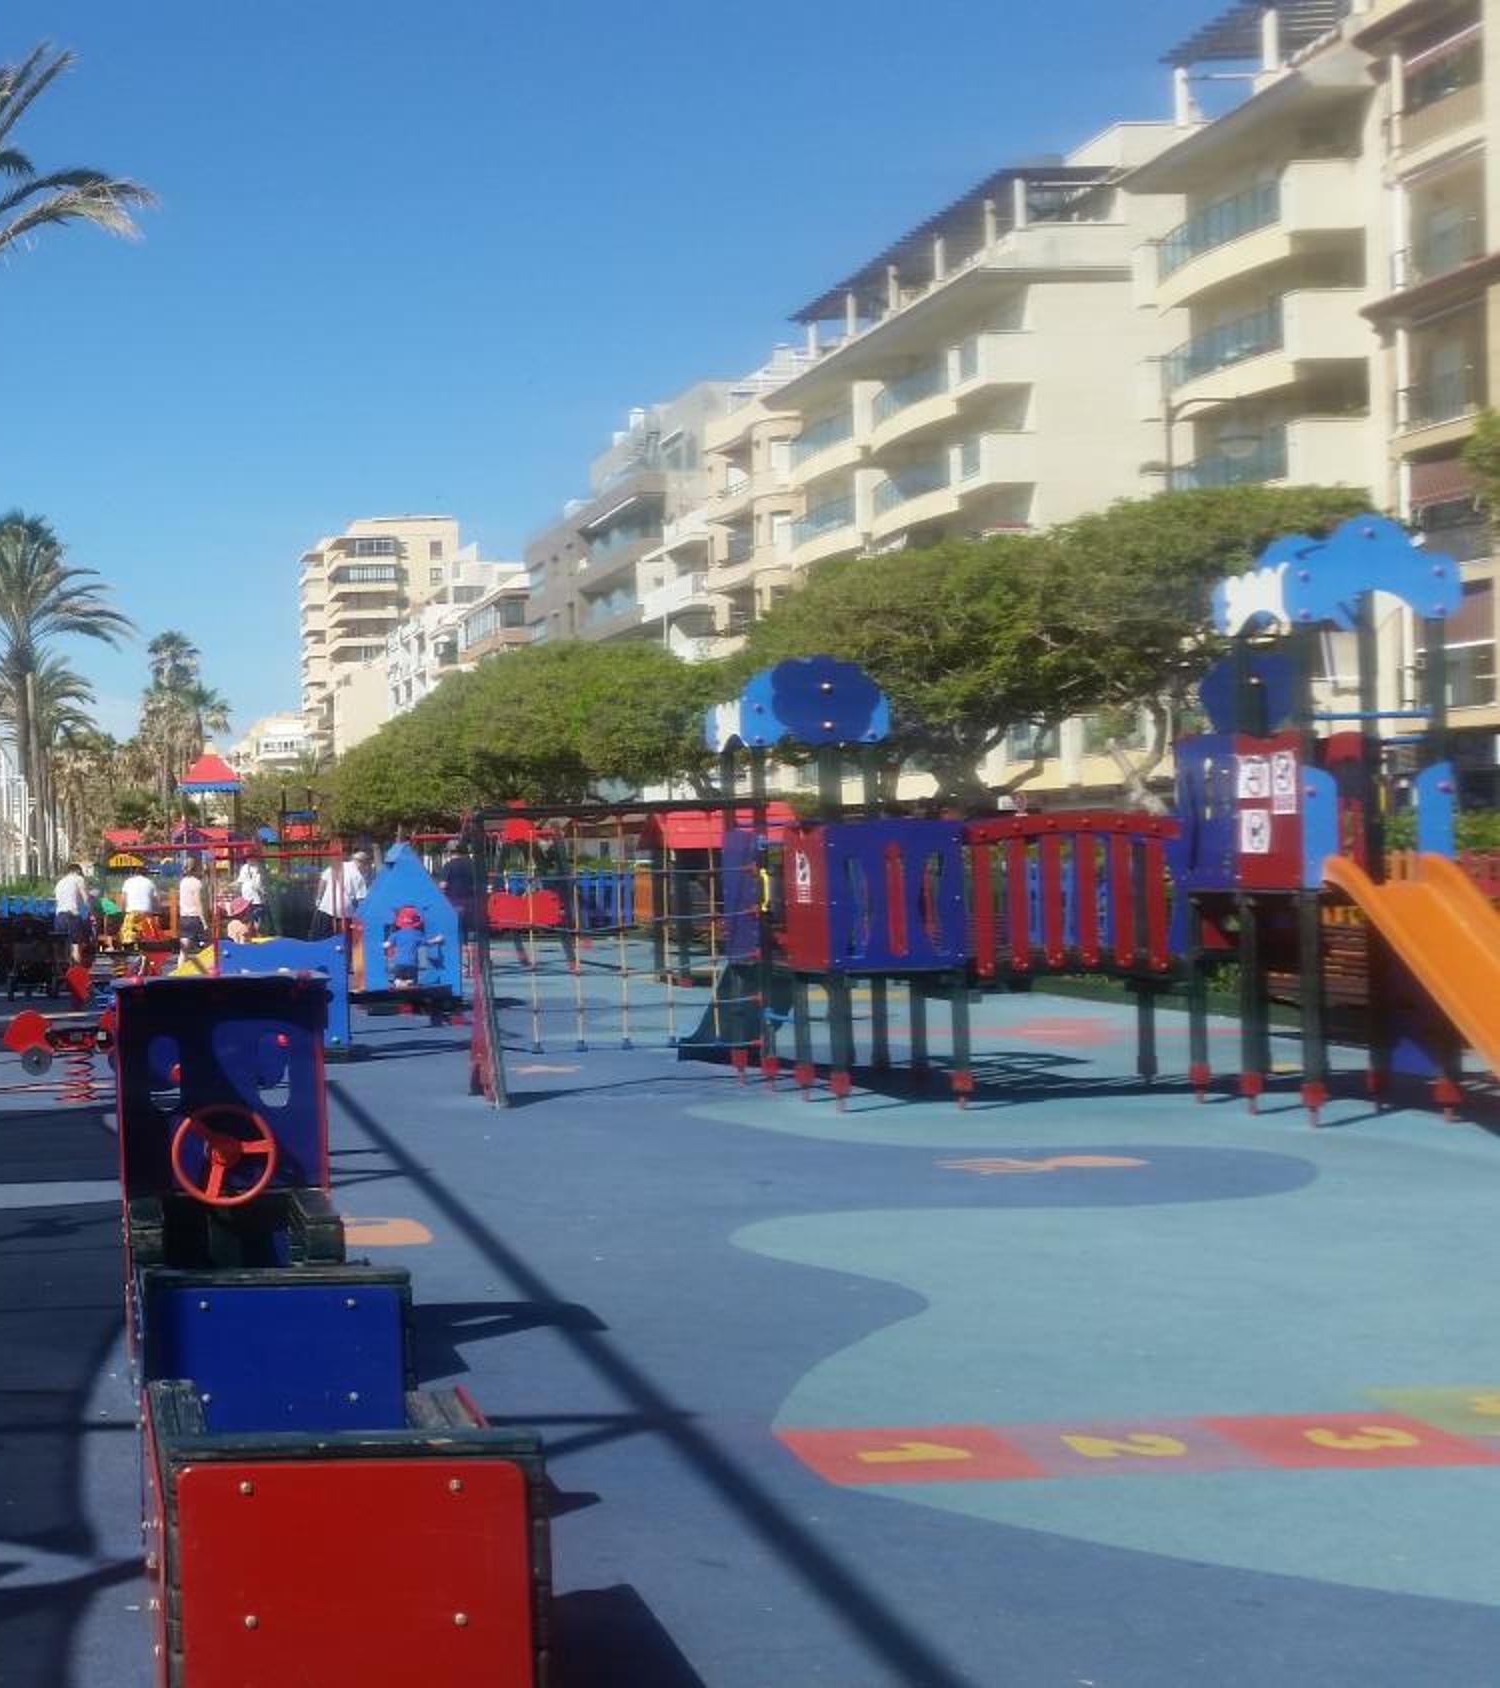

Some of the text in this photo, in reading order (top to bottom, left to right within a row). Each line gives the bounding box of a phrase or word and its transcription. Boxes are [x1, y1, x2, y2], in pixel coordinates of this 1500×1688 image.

[856, 1426, 1420, 1463] 1 2 3
